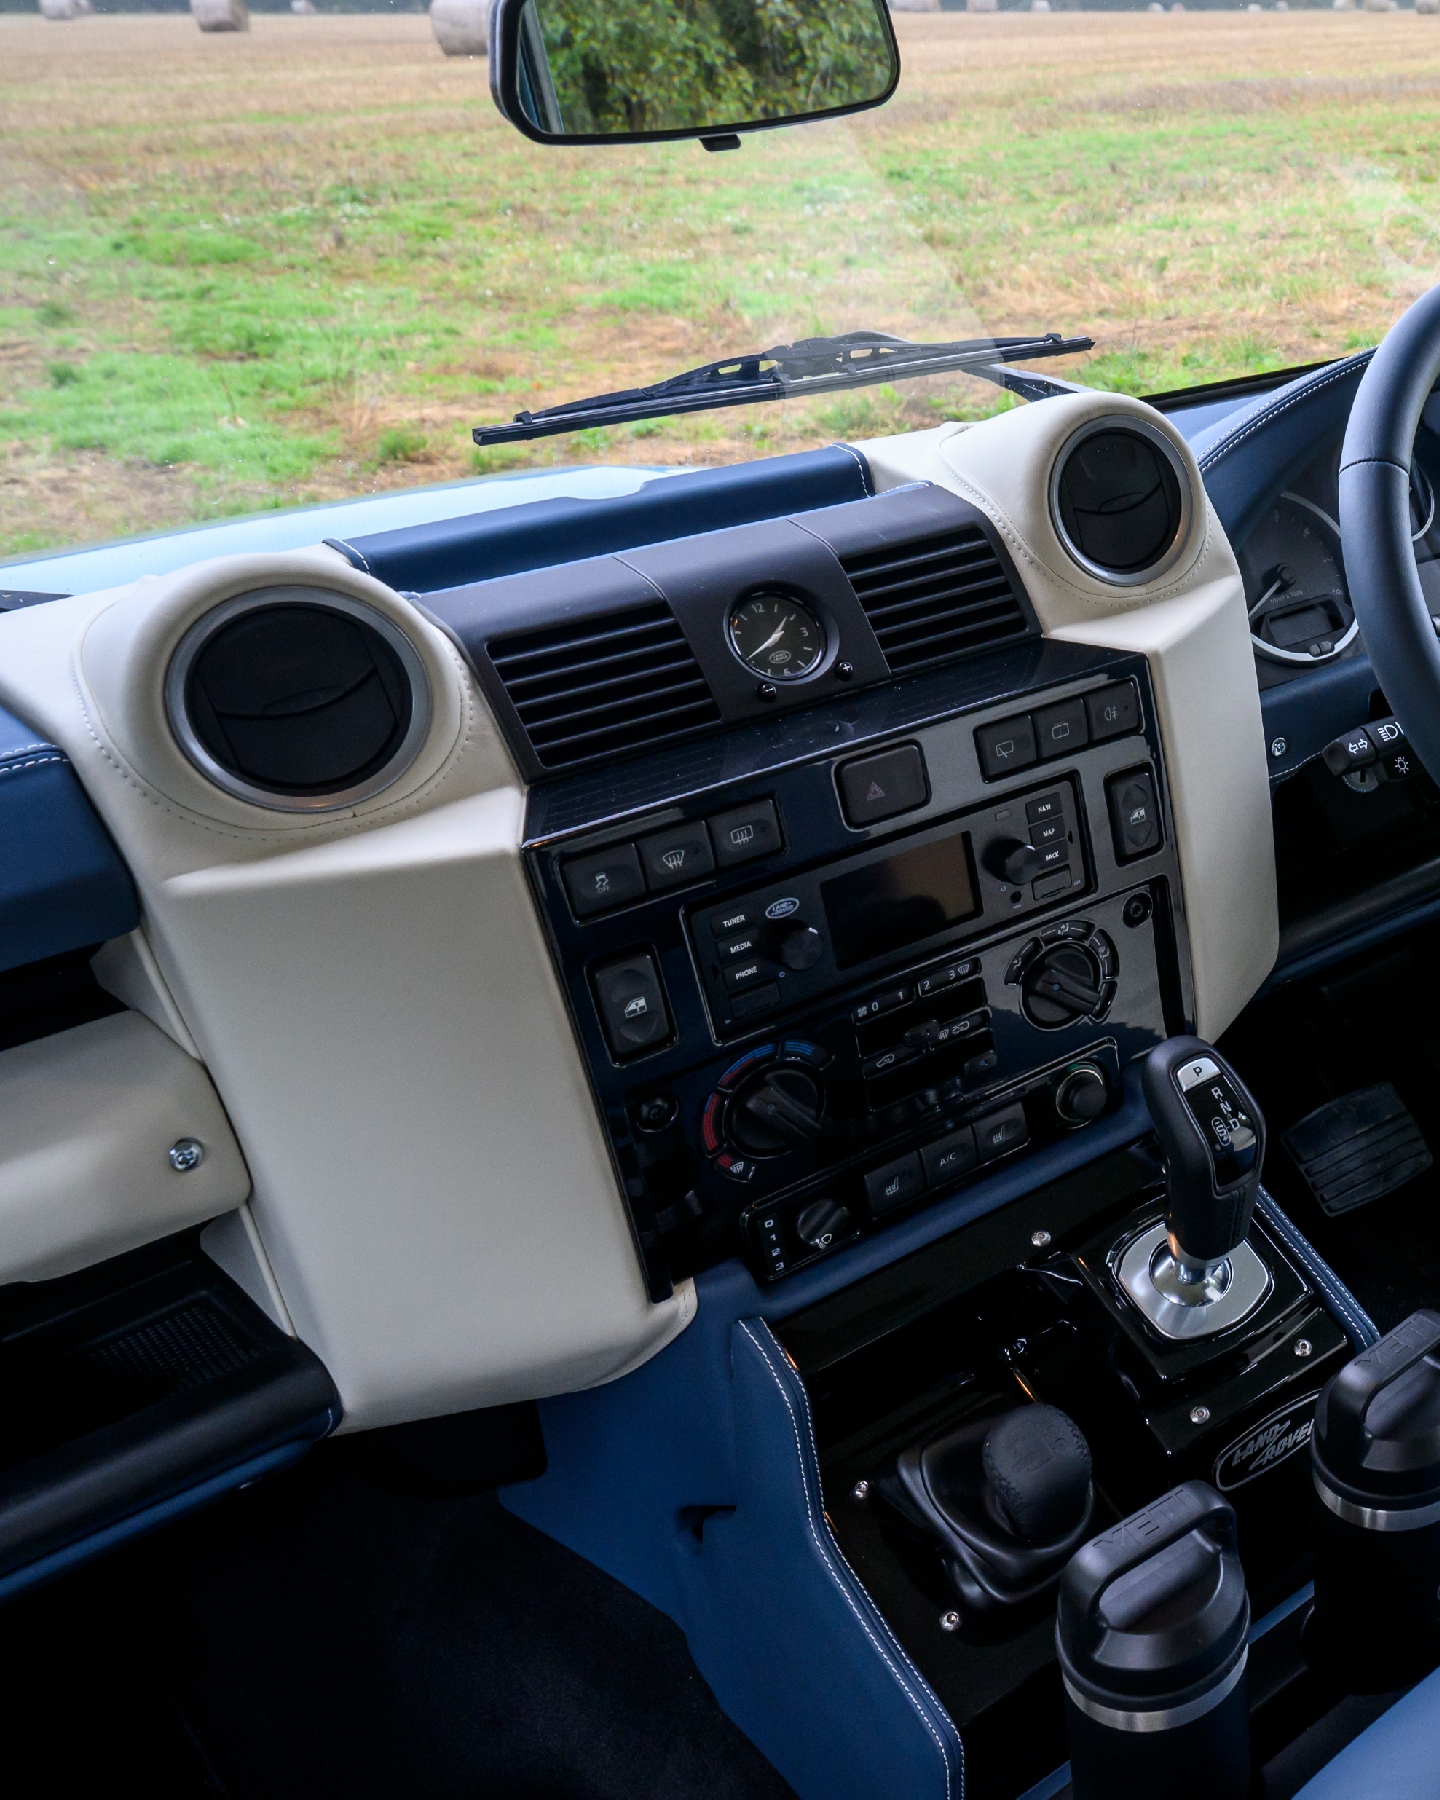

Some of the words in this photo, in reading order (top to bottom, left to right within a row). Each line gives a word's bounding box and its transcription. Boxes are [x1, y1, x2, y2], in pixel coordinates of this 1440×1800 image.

[751, 603, 765, 613] 12
[800, 627, 809, 636] 3
[1043, 827, 1056, 837] MAP
[1045, 850, 1060, 861] BACK
[722, 914, 746, 928] TUNER
[729, 941, 752, 954] MEDIA
[735, 965, 758, 980] PHONE
[871, 1001, 879, 1012] 0
[897, 991, 904, 1001] 1
[923, 980, 931, 991] 2
[948, 970, 956, 980] 3
[1193, 1066, 1203, 1077] P
[1211, 1086, 1223, 1099] R
[1219, 1100, 1232, 1115] N
[1229, 1118, 1241, 1131] D
[939, 1151, 956, 1167] A/C
[764, 1219, 774, 1229] 0
[770, 1233, 777, 1241] 1
[771, 1247, 781, 1257] 2
[775, 1261, 785, 1271] 3
[1353, 1314, 1438, 1370] YETI
[1231, 1422, 1284, 1467] LAND
[1260, 1418, 1316, 1466] ROVE
[1091, 1488, 1201, 1557] YETI
